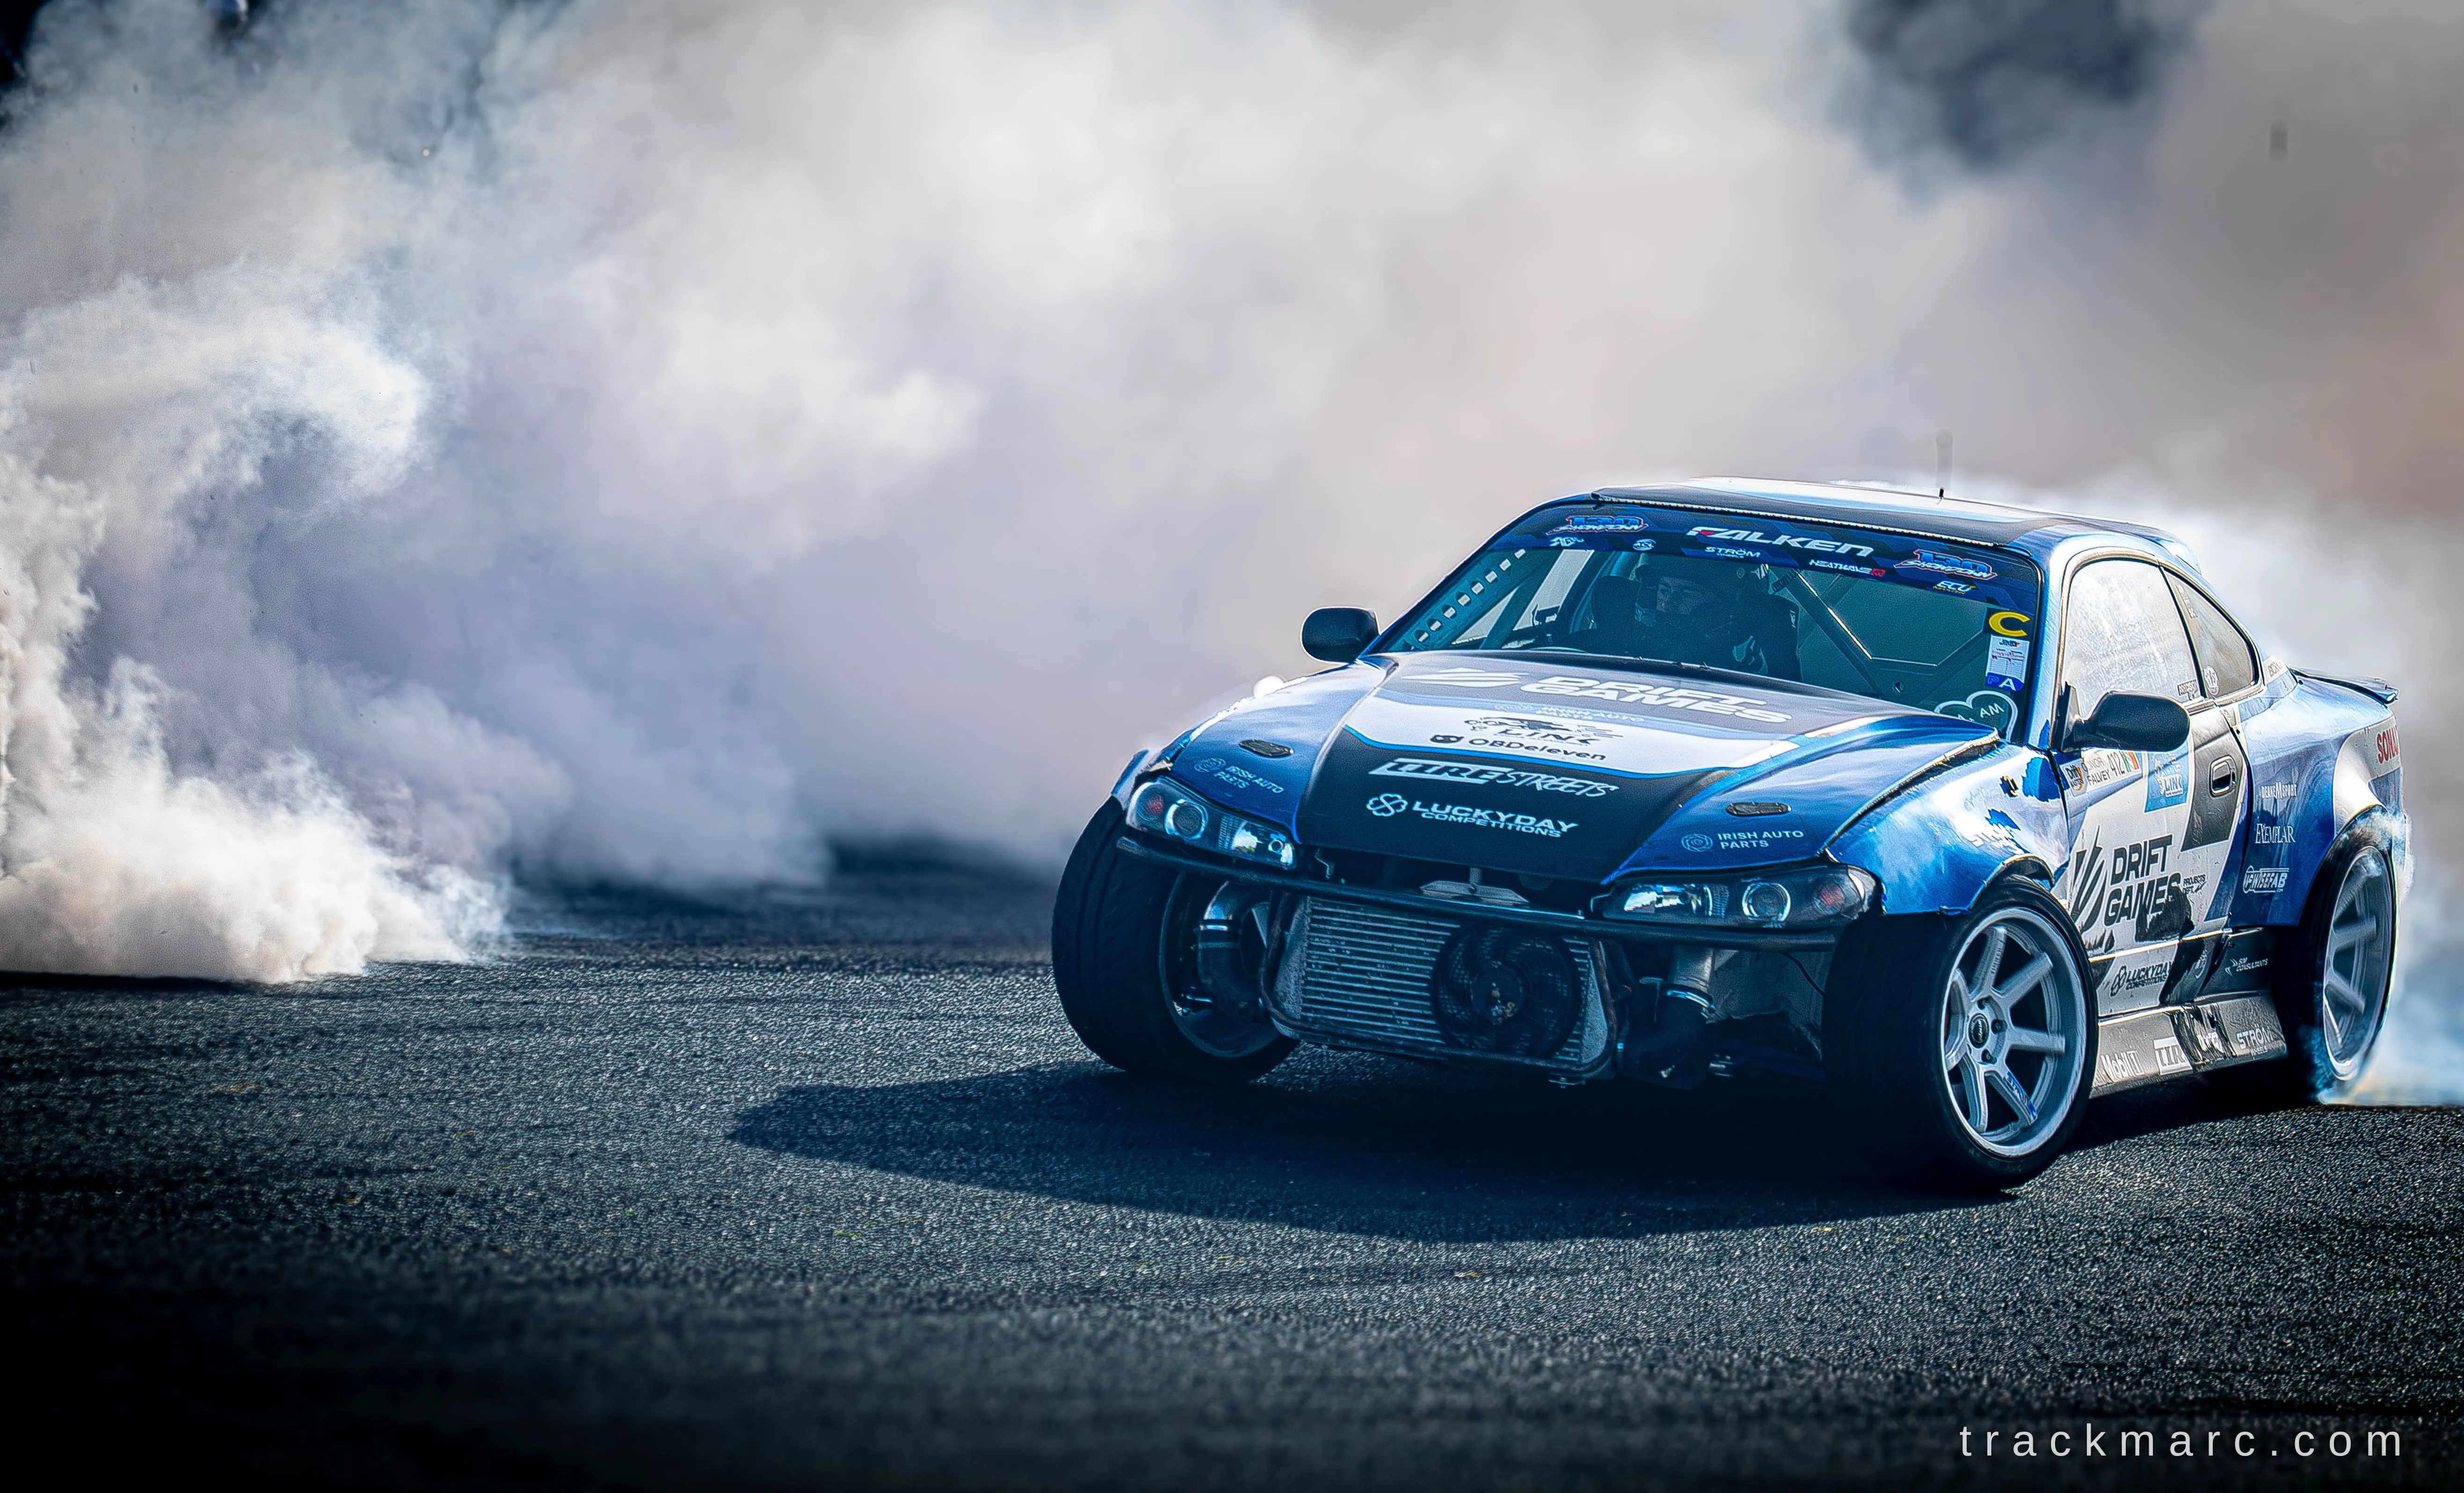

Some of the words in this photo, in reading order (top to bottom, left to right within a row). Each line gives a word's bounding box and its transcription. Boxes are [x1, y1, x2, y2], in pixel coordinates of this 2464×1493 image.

[1686, 526, 1874, 557] FALKEN
[1936, 581, 1972, 592] ECU
[1989, 611, 2031, 637] C
[1537, 676, 1767, 707] DRIFT
[1998, 677, 2017, 692] A
[1520, 683, 1792, 723] GAMES
[1980, 702, 2005, 719] AM
[1469, 738, 1606, 761] OBDeleven
[2377, 725, 2399, 764] SONA
[2107, 750, 2125, 777] 412
[1252, 777, 1284, 794] AUTO
[1495, 771, 1620, 797] STREETS
[2086, 769, 2111, 787] FALVEY
[1412, 800, 1579, 833] LUCKYDAY
[1421, 812, 1562, 838] COMPETITIONS
[1717, 831, 1759, 841] IRISH
[1762, 830, 1804, 839] AUTO
[1720, 840, 1769, 850] PARTS
[2254, 823, 2296, 844] EXEMPLAR
[2110, 834, 2173, 886] DRIFT
[2100, 1051, 2134, 1080] Mobil
[2156, 1044, 2187, 1067] TIR
